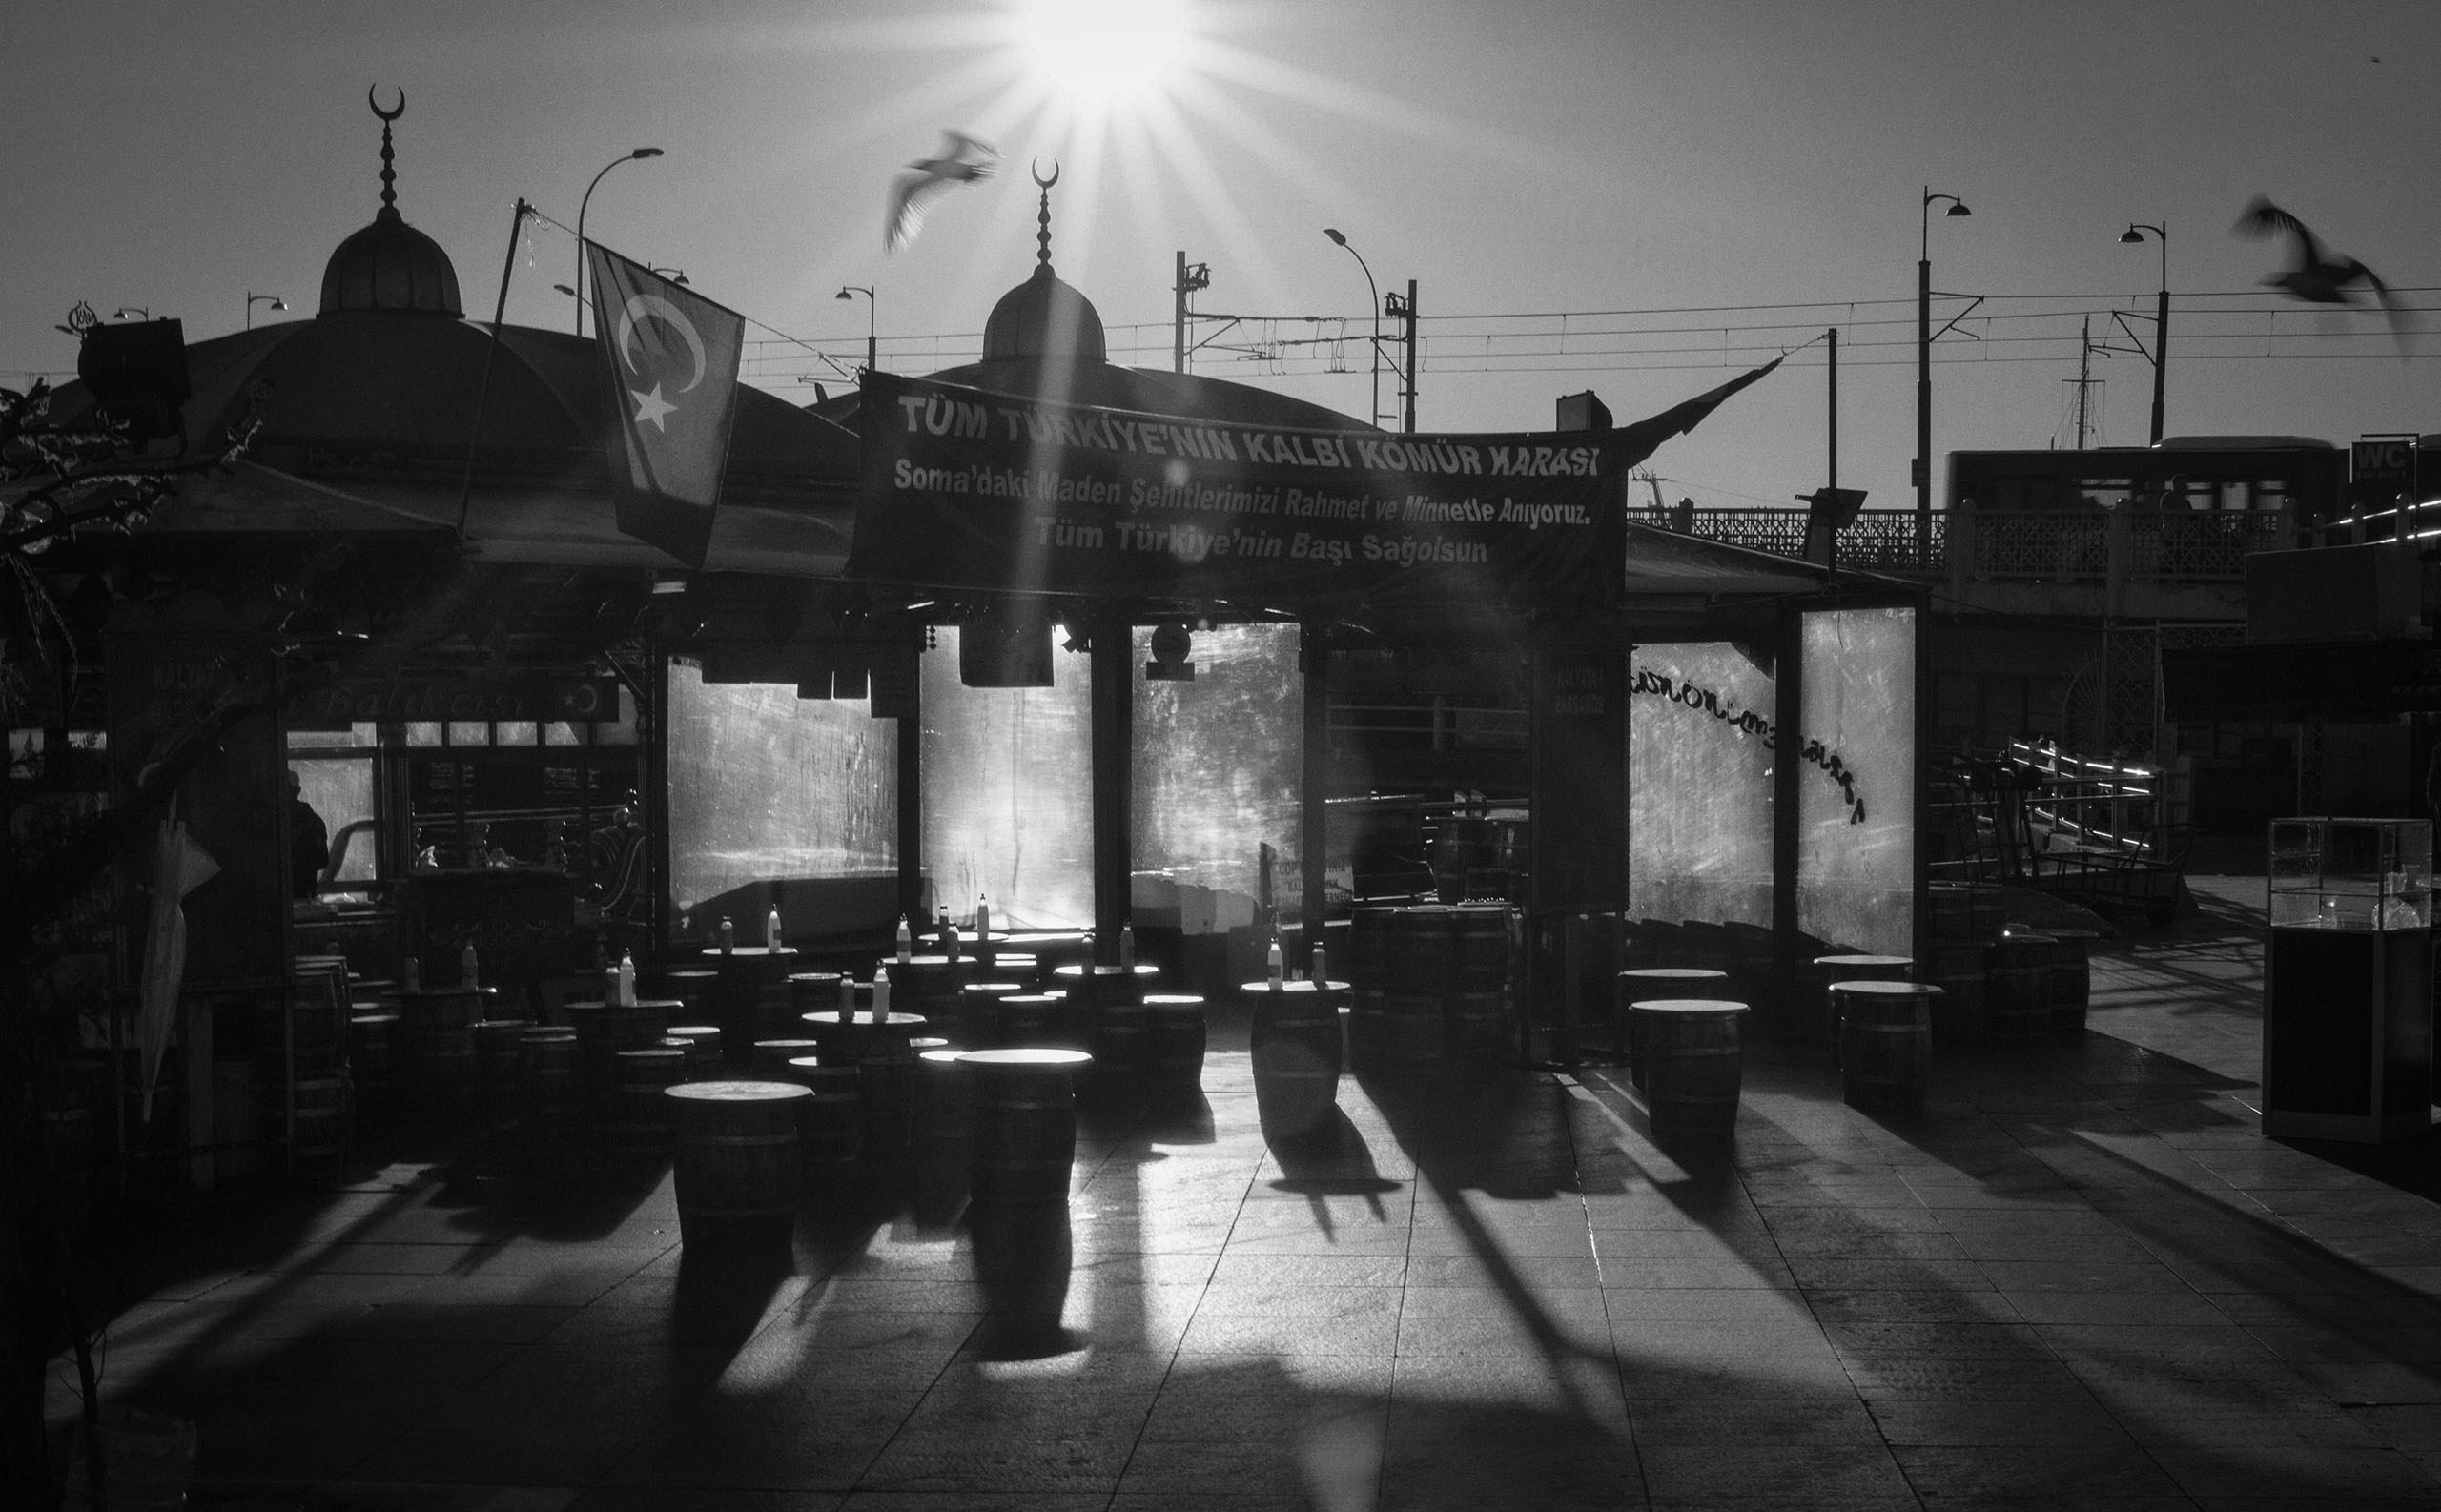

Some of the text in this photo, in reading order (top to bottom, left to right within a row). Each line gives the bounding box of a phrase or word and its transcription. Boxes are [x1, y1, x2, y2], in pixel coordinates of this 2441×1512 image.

[898, 392, 989, 439] TÜM
[1242, 432, 1351, 468] KALBİ
[1356, 437, 1482, 475] KÖMÜR
[1488, 446, 1601, 477] KARASI
[2355, 443, 2408, 469] WC
[894, 458, 1590, 530] Soma'daki Maden Şehitlerimizi Rahmet ve Minnetle Anıyoruz.
[1035, 516, 1488, 568] Tüm Türkiye'nin Başı Sağolsun
